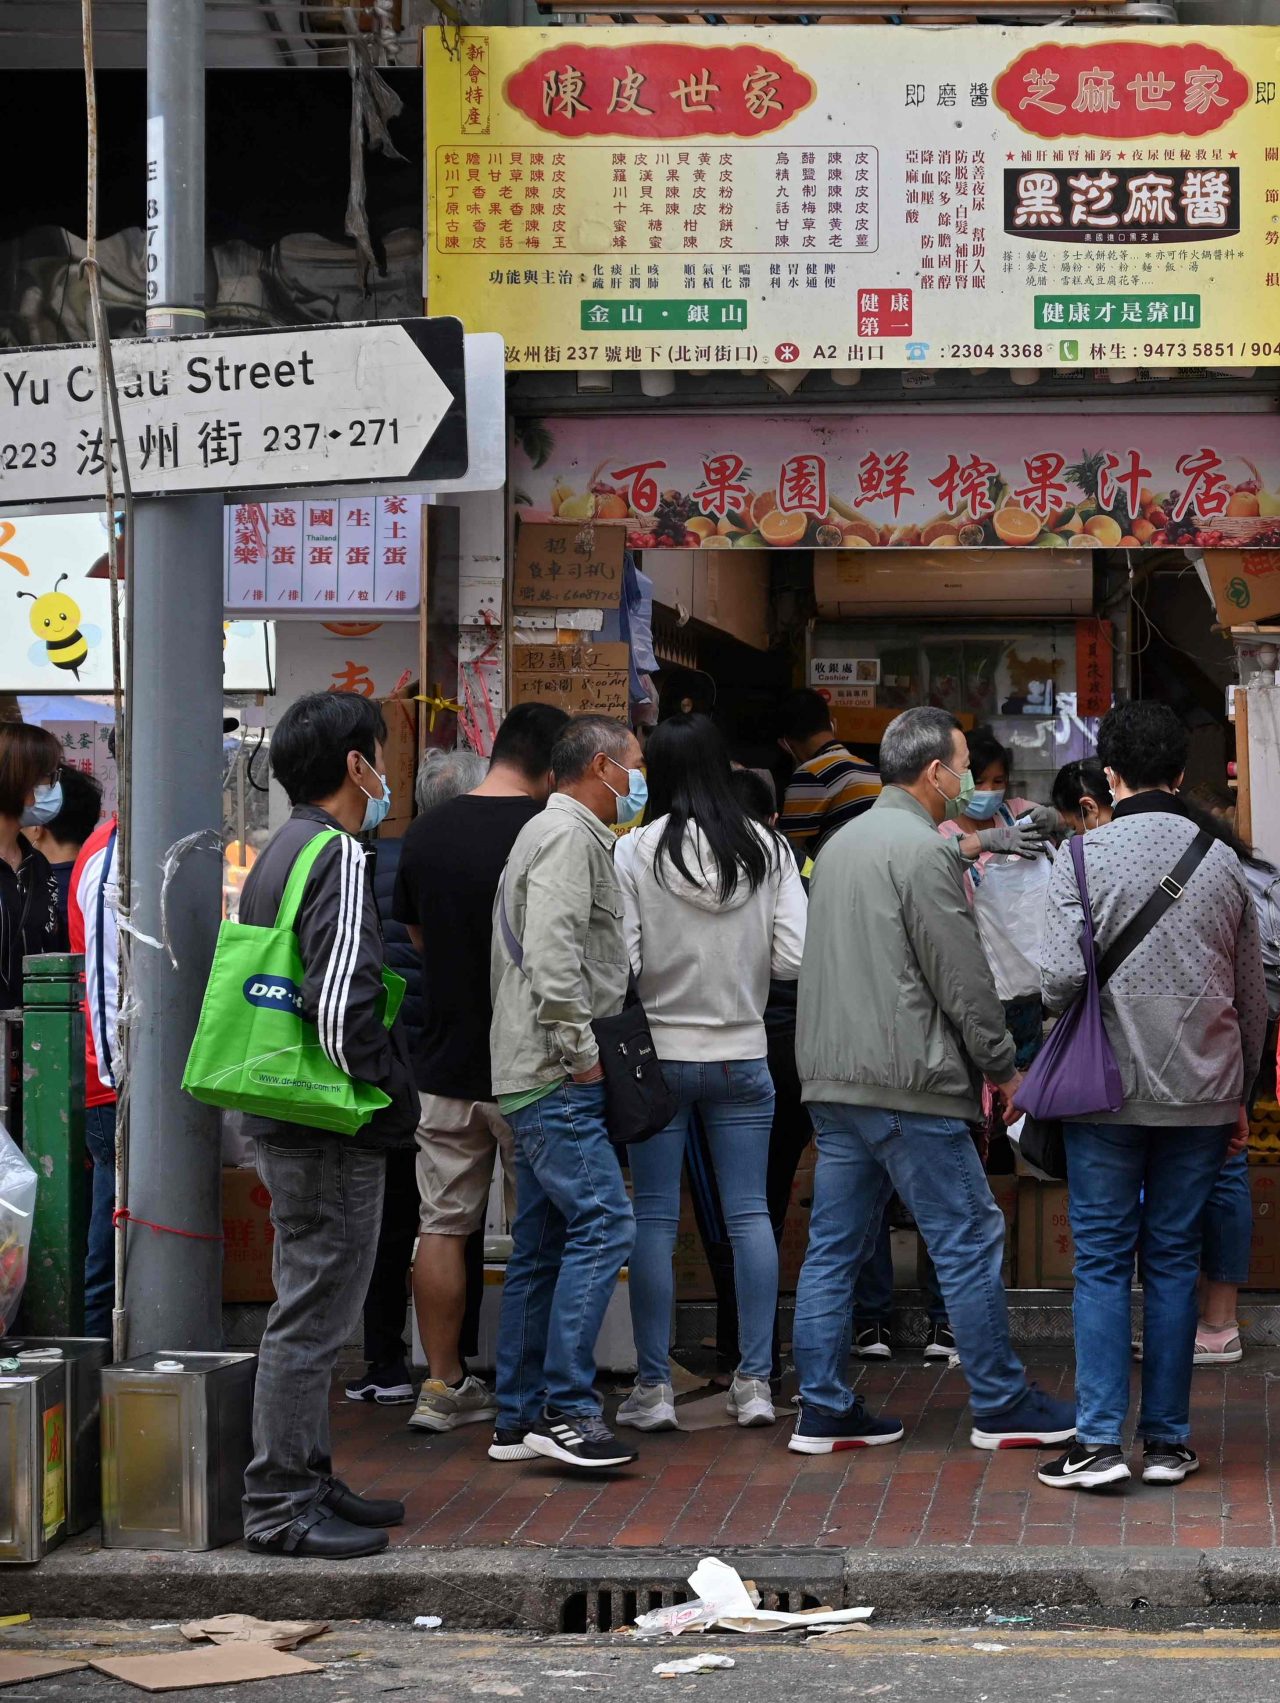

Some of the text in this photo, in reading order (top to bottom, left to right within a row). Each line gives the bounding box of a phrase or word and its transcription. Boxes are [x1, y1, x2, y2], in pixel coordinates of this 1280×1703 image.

[464, 44, 484, 126] 新會特產
[542, 64, 786, 120] 陳皮世家
[904, 82, 990, 108] 即磨醬
[1018, 64, 1230, 114] 芝麻世家
[444, 152, 566, 166] 蛇膽川貝陳皮
[612, 152, 733, 166] 陳皮川貝黃皮
[444, 169, 566, 182] 川貝甘草陳皮
[612, 169, 733, 182] 羅漢果黃皮
[905, 149, 919, 224] 亞麻油酸
[920, 149, 934, 205] 降血壓
[444, 185, 869, 199] 丁香老陳皮 川貝陳皮粉 九制陳皮
[1013, 171, 1230, 226] 黑芝麻醬
[444, 202, 869, 216] 原味果香陳皮 十年陳皮粉 話梅陳皮
[937, 149, 951, 290] 消除多餘膽固醇
[955, 205, 968, 235] 白髮
[972, 149, 986, 290] 改善夜尿 幫助入眠
[1265, 146, 1280, 287] 關節勞損
[444, 219, 869, 233] 古香老陳皮 蜜糖柑餅 甘草黃皮
[444, 235, 566, 249] 陳皮話梅王
[612, 235, 733, 249] 蜂蜜陳皮
[592, 263, 836, 276] 化痰止咳 順氣平喘 健胃健脾
[955, 243, 968, 290] 補肝腎
[769, 277, 836, 289] 利水通便
[860, 292, 910, 313] 健康
[1041, 301, 1195, 324] 健康才是靠山
[860, 316, 909, 337] 第一
[566, 346, 598, 360] 237
[604, 344, 663, 363] 號地下
[813, 345, 837, 360] A2
[848, 344, 884, 361] 出口
[951, 343, 994, 359] 2304
[1000, 343, 1043, 359] 3368
[1143, 342, 1188, 358] 9473
[1192, 342, 1236, 358] 5851
[5, 350, 315, 407] Yu Cau Street
[1, 442, 57, 469] 223
[349, 418, 400, 447] 271
[610, 447, 1241, 521] 百果園鮮榨果汁店
[306, 534, 337, 542] Thailand
[258, 1073, 342, 1094] www.dr-kong.com.hk
